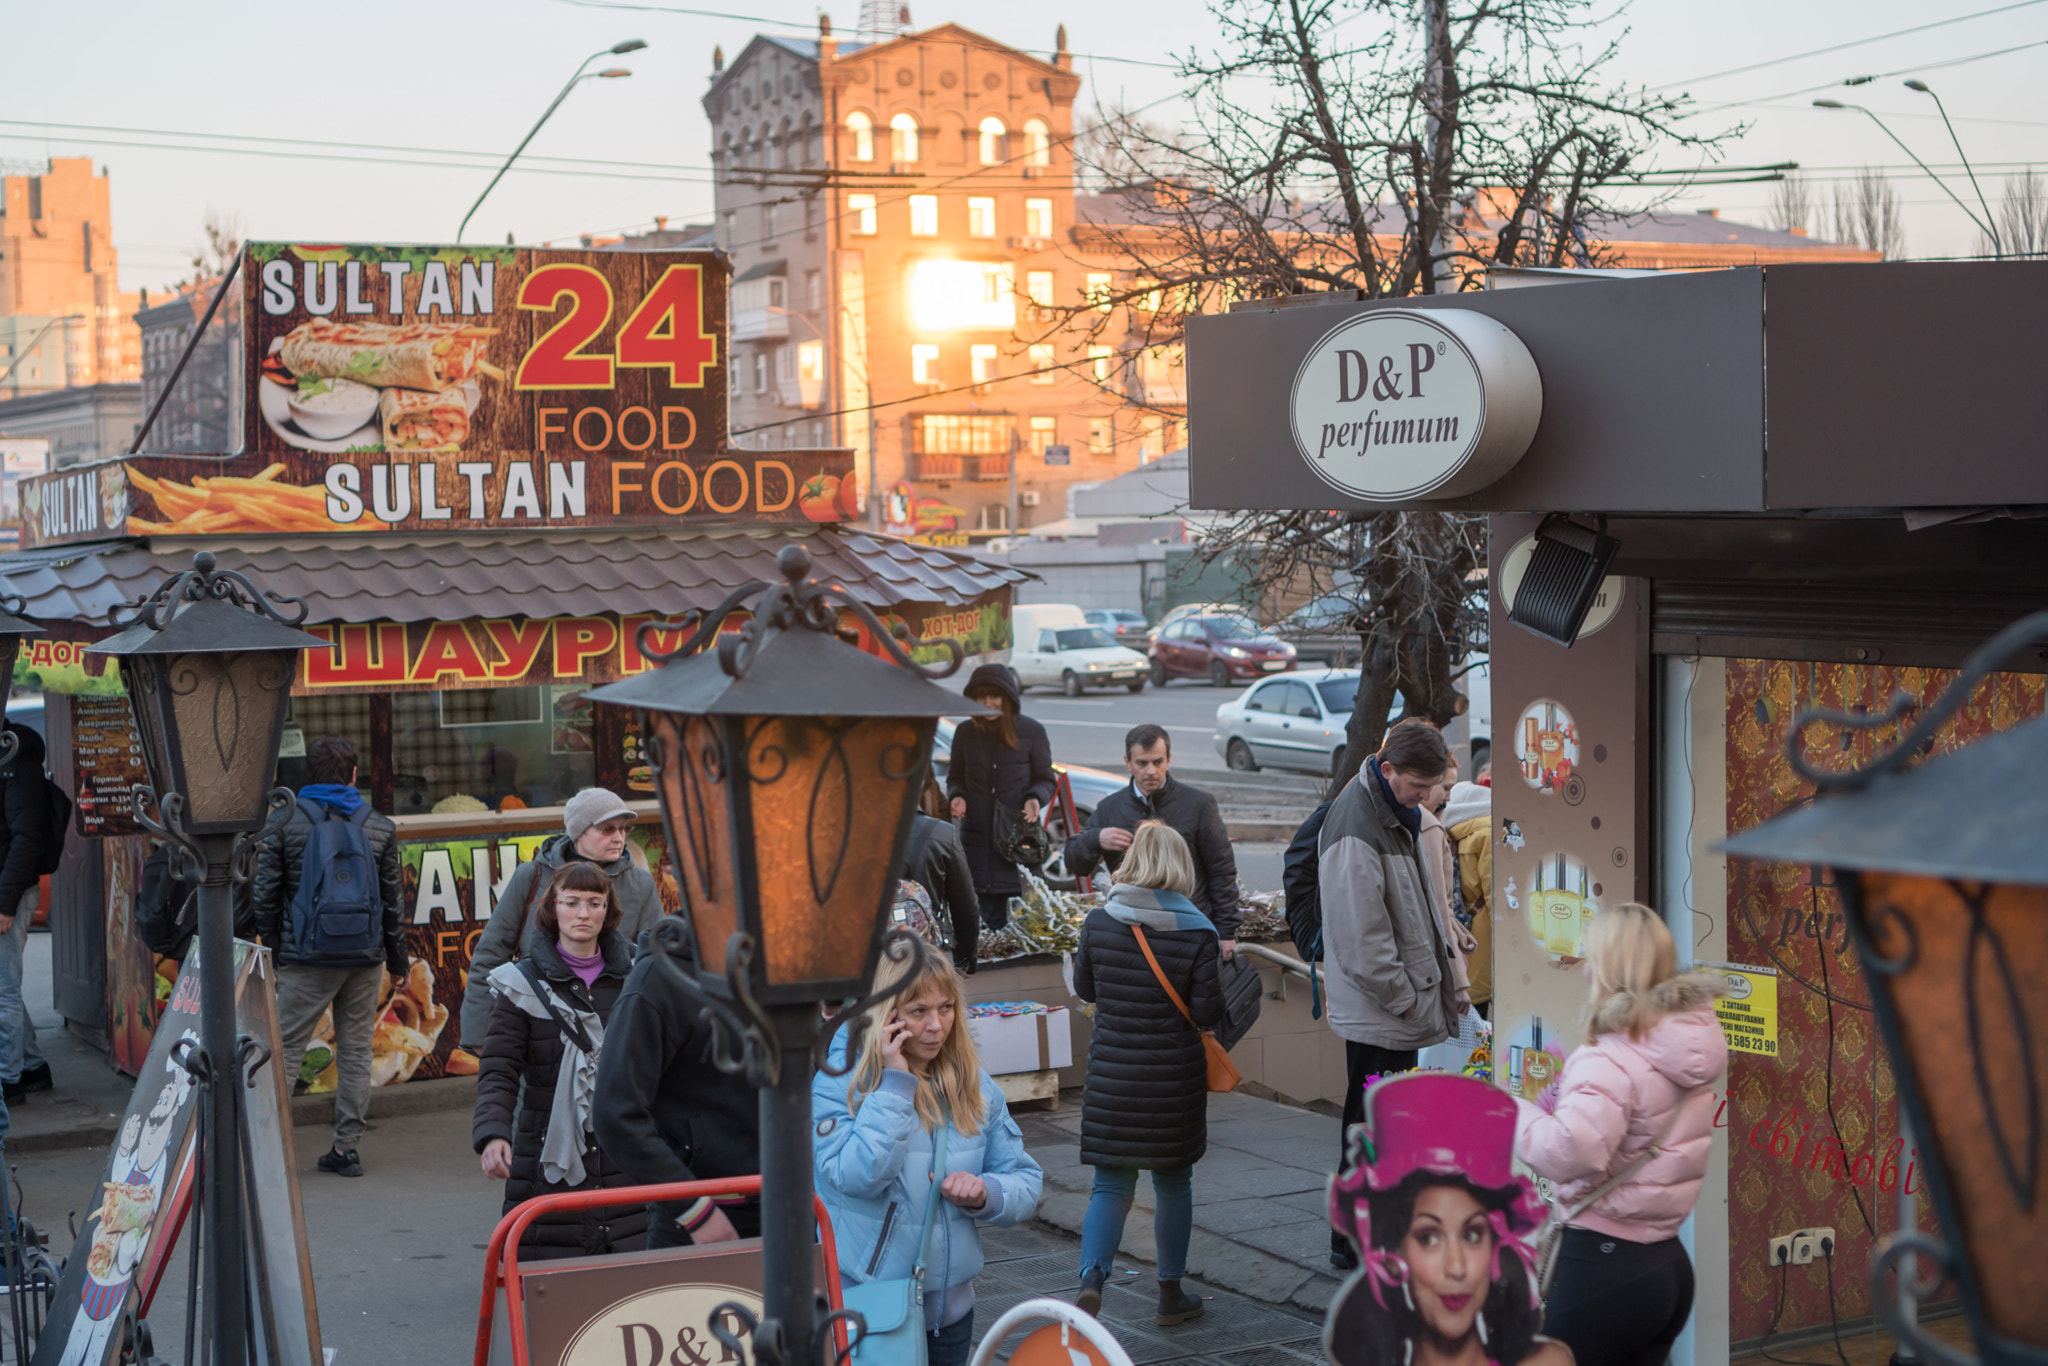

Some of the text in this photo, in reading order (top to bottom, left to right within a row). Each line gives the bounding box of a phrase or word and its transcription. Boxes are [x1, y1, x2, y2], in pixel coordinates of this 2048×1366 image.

[262, 260, 495, 315] SULTAN
[514, 262, 718, 390] 24
[539, 406, 697, 452] FOOD
[1317, 409, 1459, 458] perfumum
[41, 470, 98, 539] SULTAN
[324, 460, 796, 523] SULTAN FOOD
[78, 707, 125, 716] Американо
[1734, 1034, 1751, 1048] 585
[1752, 1038, 1763, 1051] 23
[1764, 1039, 1776, 1053] 90
